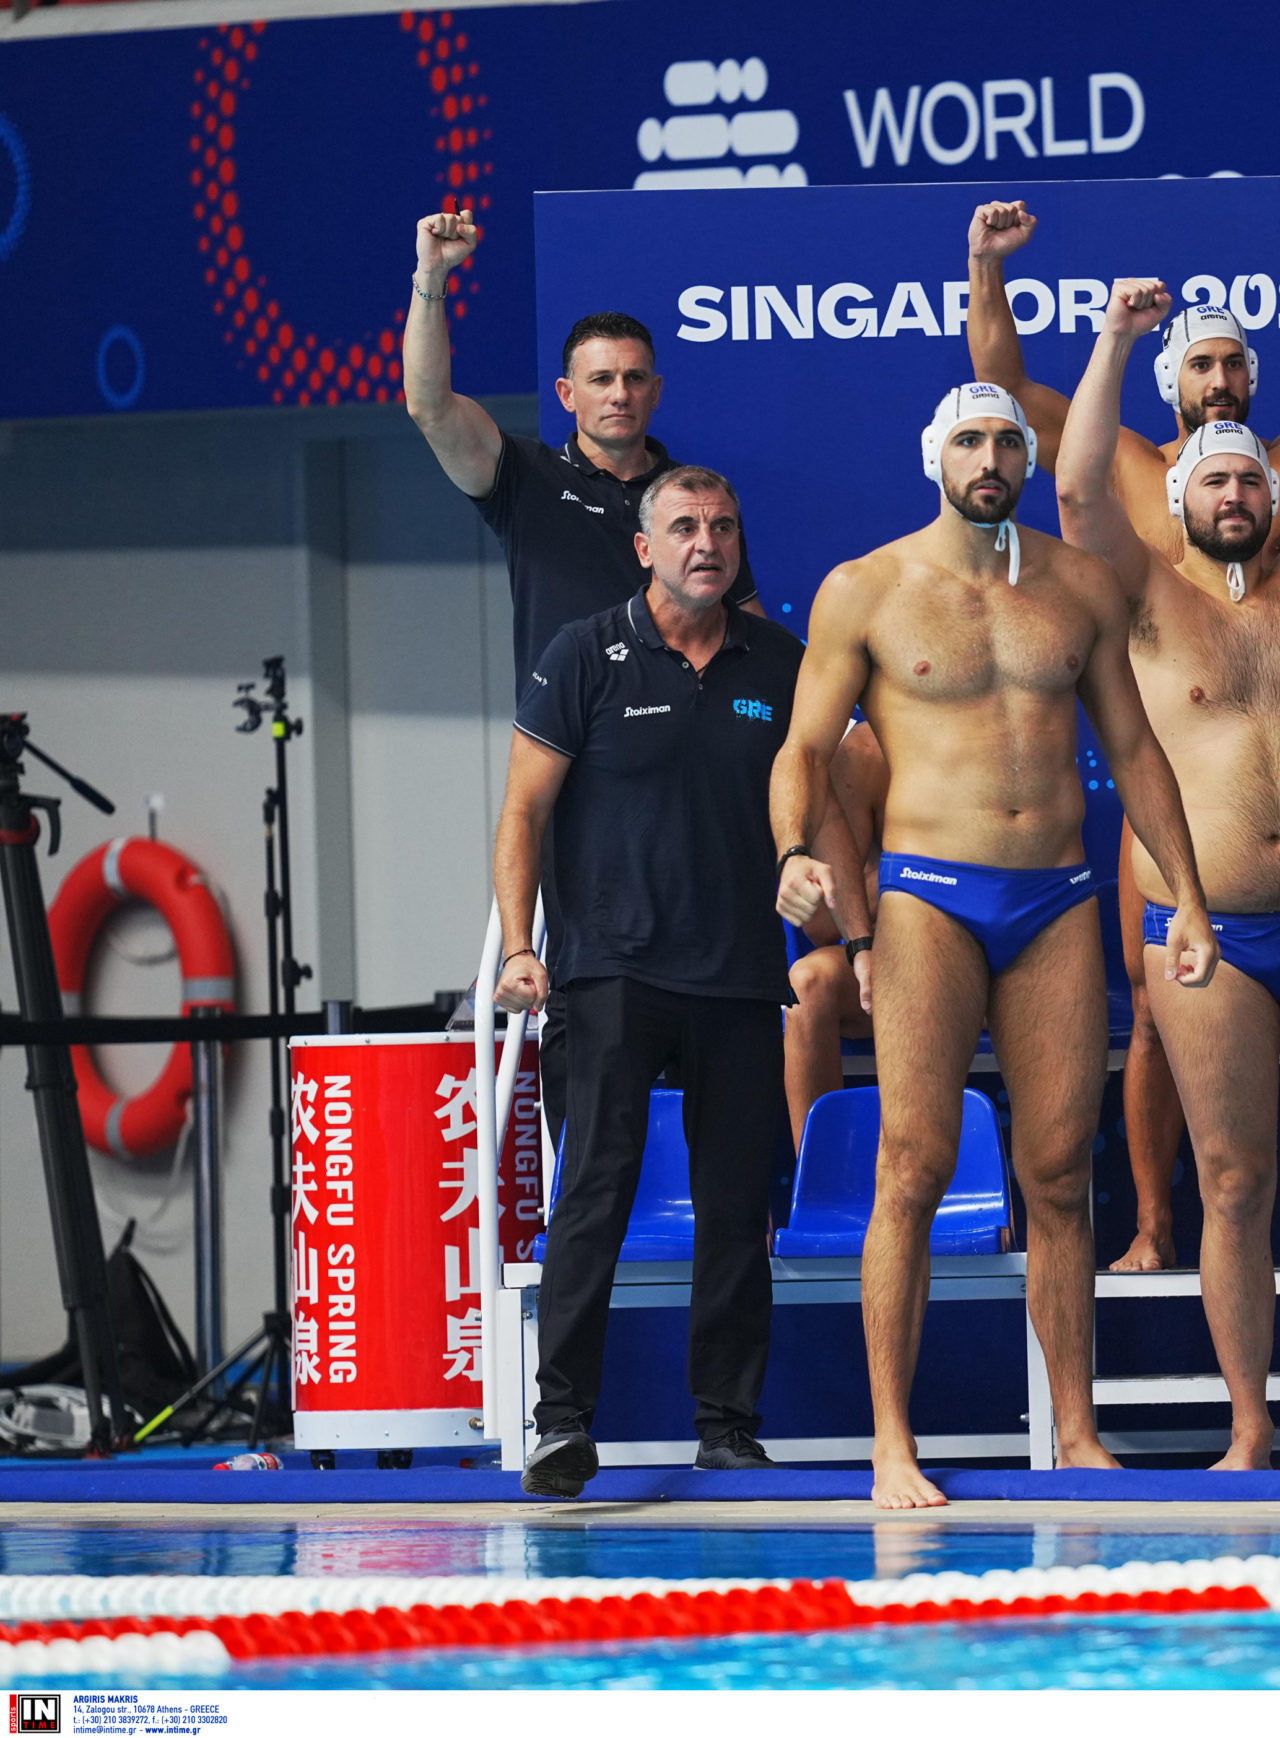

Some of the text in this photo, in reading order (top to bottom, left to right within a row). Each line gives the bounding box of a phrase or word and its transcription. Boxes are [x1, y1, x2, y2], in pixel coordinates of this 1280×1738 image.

[843, 72, 1145, 168] WORLD
[1197, 306, 1224, 314] GRE
[1200, 313, 1228, 321] arena
[1214, 422, 1242, 430] GRE
[605, 641, 626, 656] arena
[623, 704, 671, 718] Stoiximan
[732, 699, 774, 722] GRE
[900, 867, 958, 886] Stoiximan
[514, 1071, 539, 1221] NONGFU
[324, 1075, 357, 1384] NONGFU SPRING
